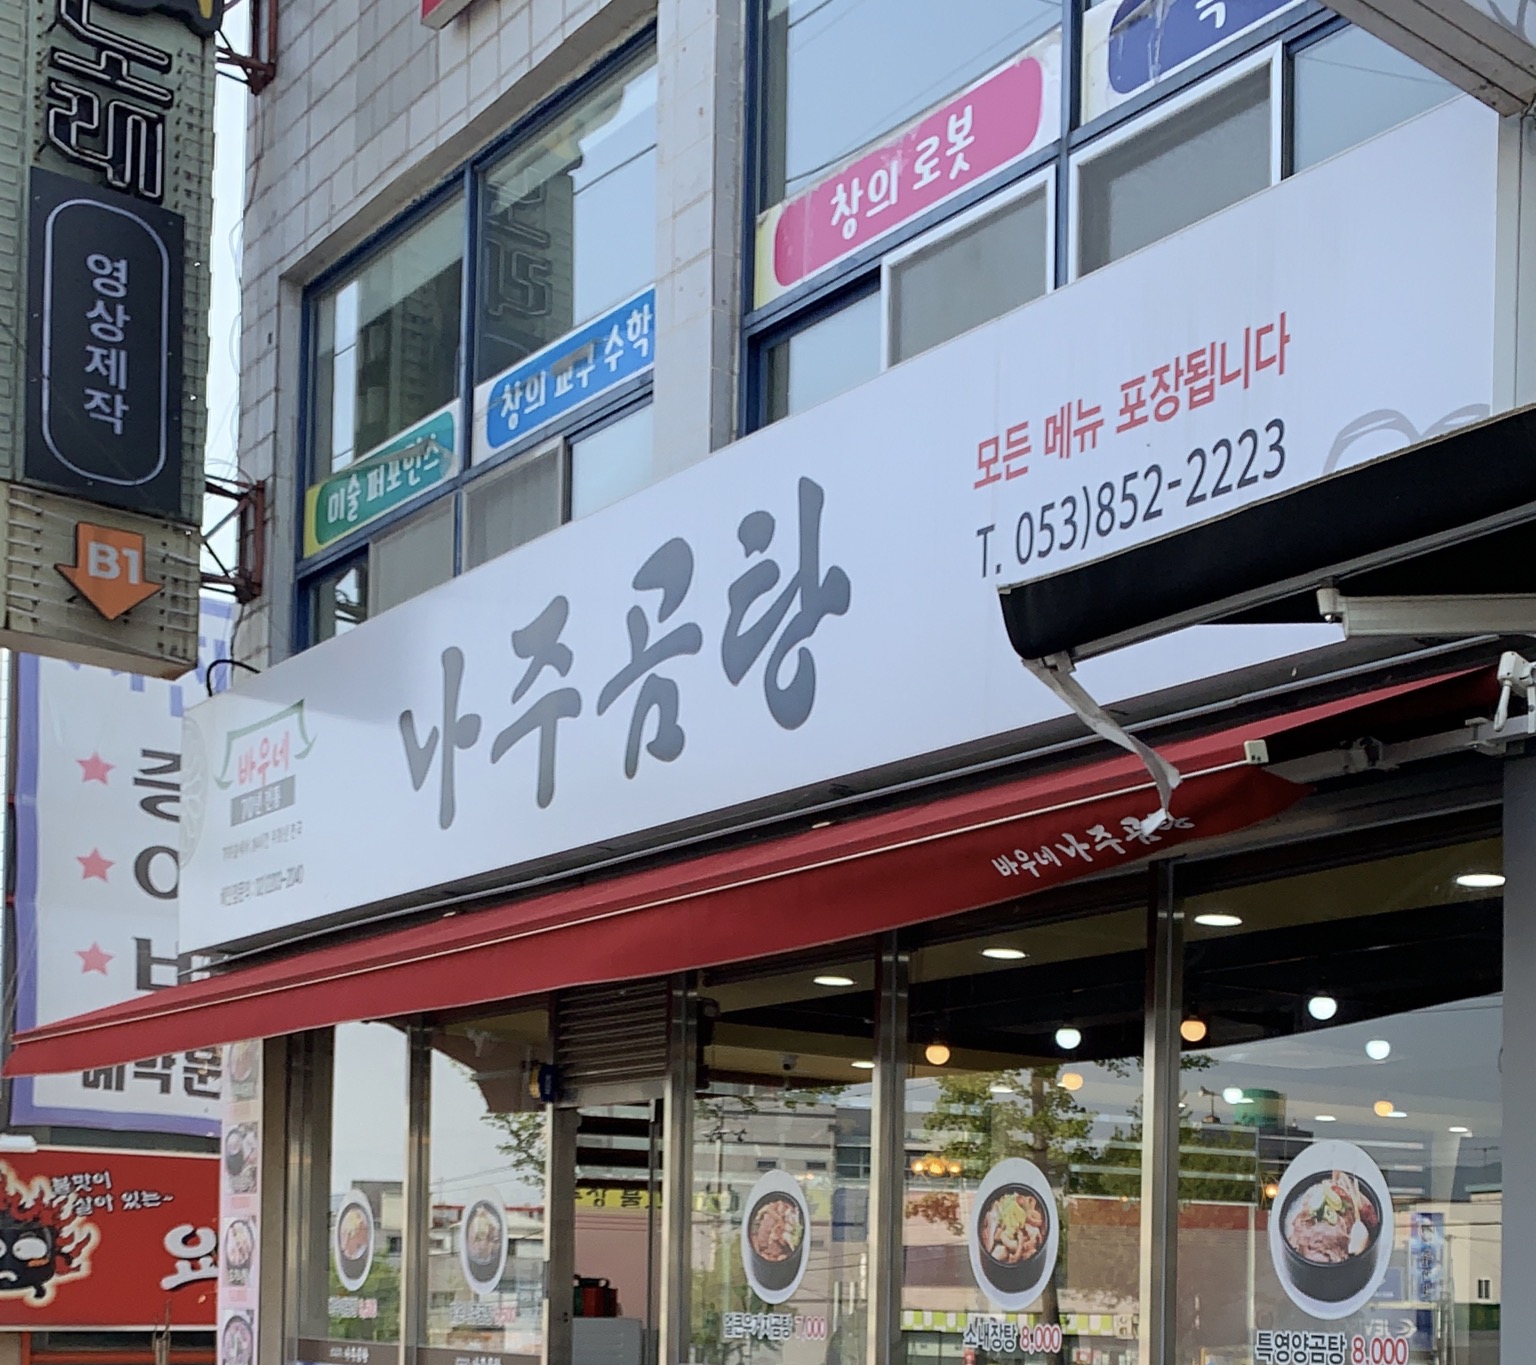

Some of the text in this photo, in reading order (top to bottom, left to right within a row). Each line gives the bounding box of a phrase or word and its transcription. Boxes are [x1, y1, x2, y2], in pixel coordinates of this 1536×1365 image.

[831, 105, 975, 240] 창의 로봇
[84, 252, 130, 436] 영상제작
[501, 370, 547, 430] 창의
[604, 304, 653, 372] 수학
[974, 311, 1290, 489] 모든 메뉴 포장됩니다
[327, 473, 361, 523] 미술
[1016, 418, 1286, 565] 053)852-2223
[86, 541, 140, 584] B1
[399, 476, 851, 829] 나주곰탕
[238, 731, 290, 788] 바우네
[991, 845, 1062, 878] 바우네
[963, 1323, 1062, 1354] 소내장탕 8,000
